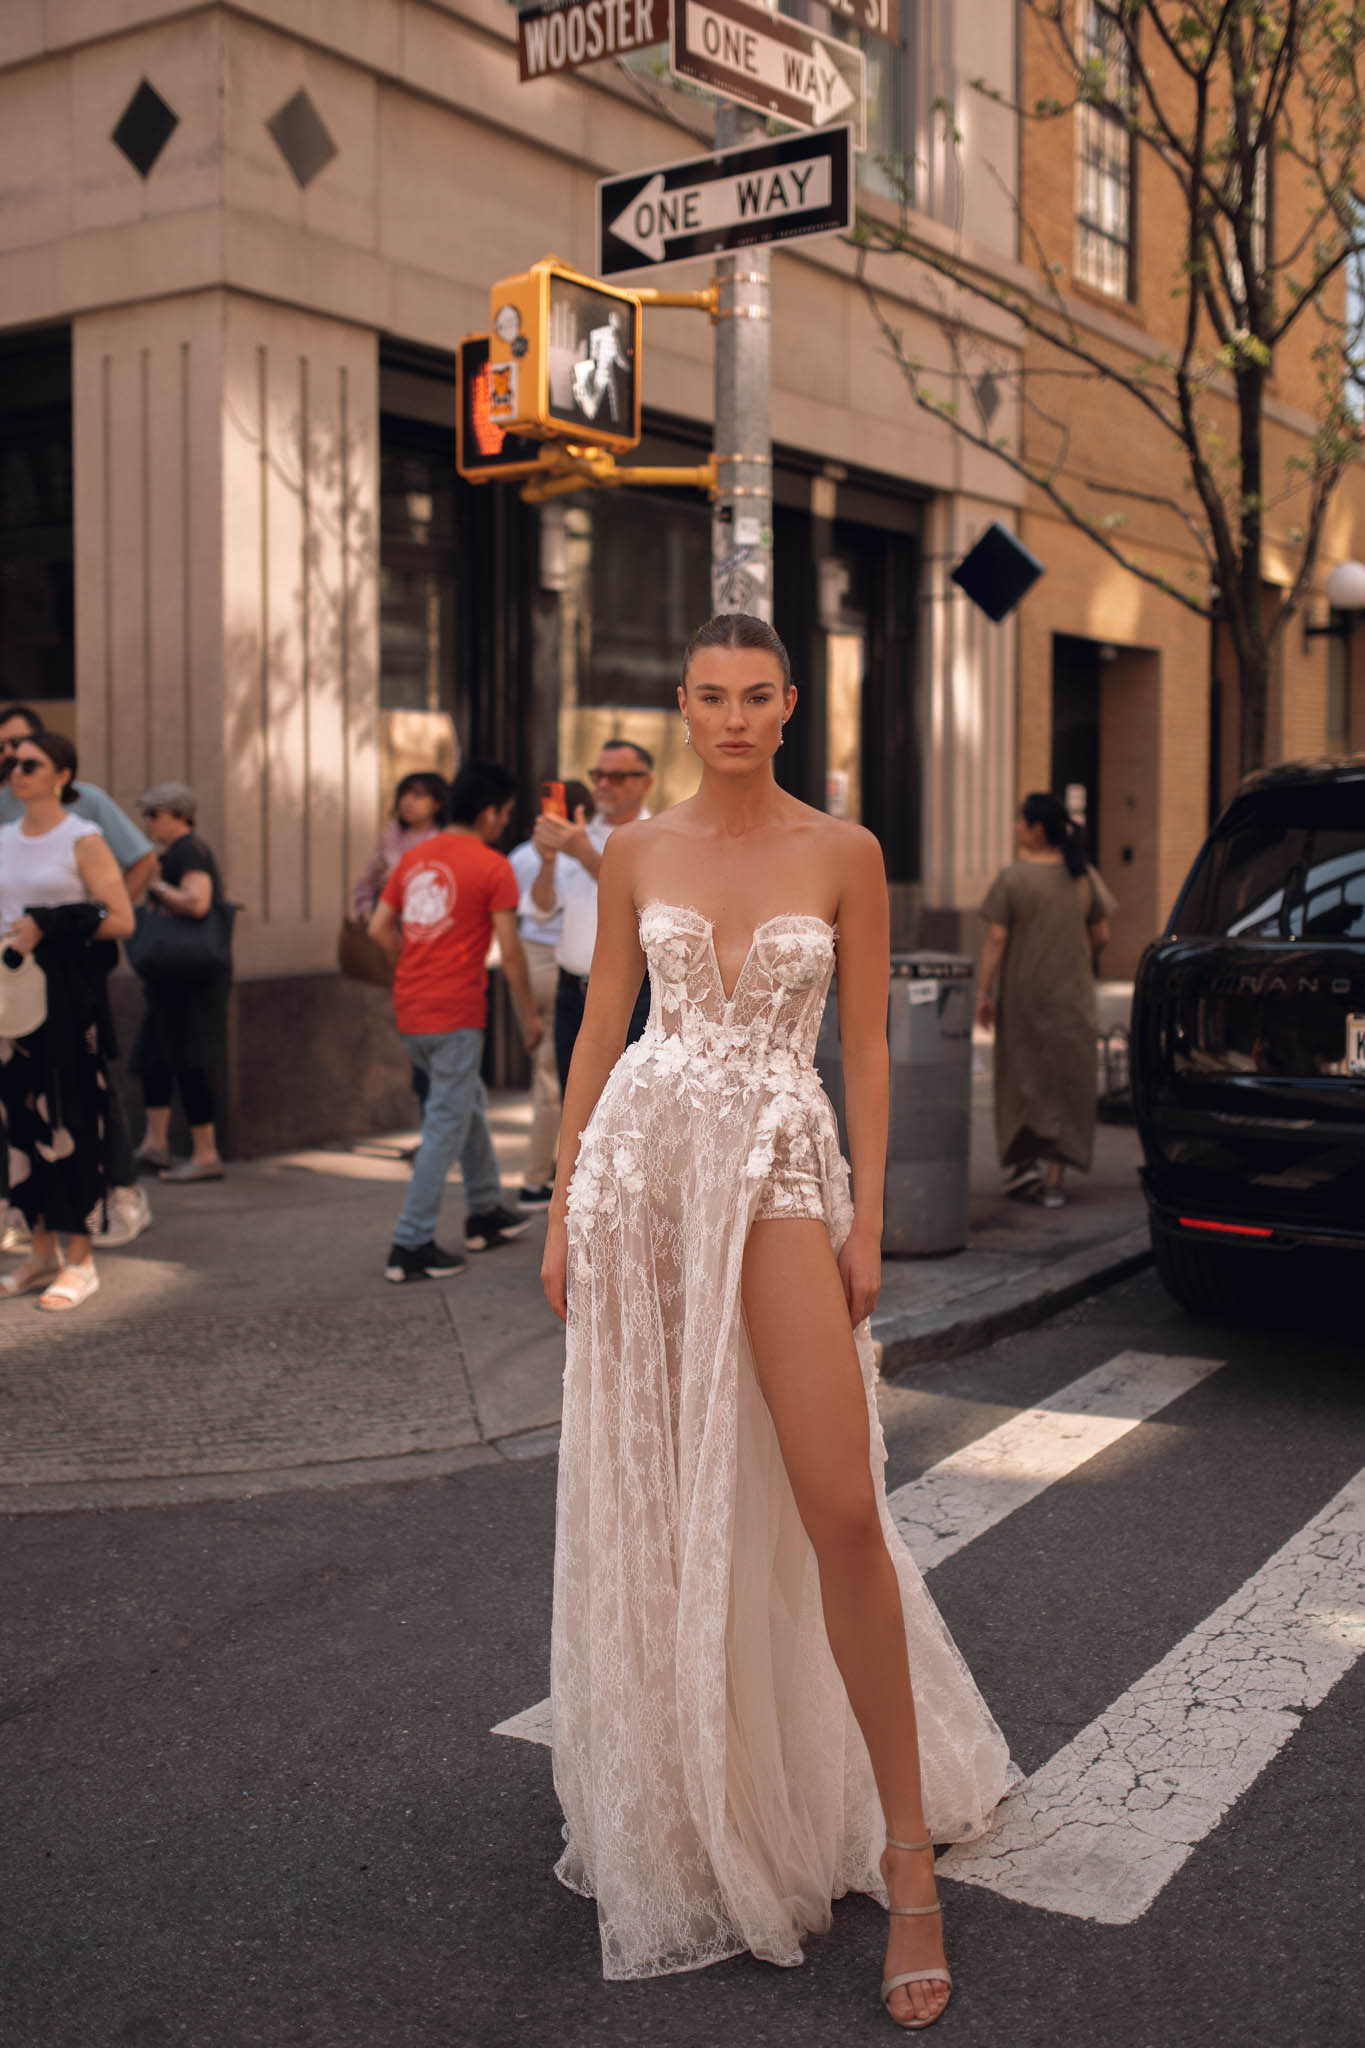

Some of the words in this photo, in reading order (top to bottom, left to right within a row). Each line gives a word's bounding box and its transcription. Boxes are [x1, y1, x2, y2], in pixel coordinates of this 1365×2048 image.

[524, 0, 654, 75] WOOSTER
[703, 16, 759, 74] ONE
[783, 52, 838, 105] WAY
[635, 192, 701, 238] ONE
[736, 165, 814, 217] WAY
